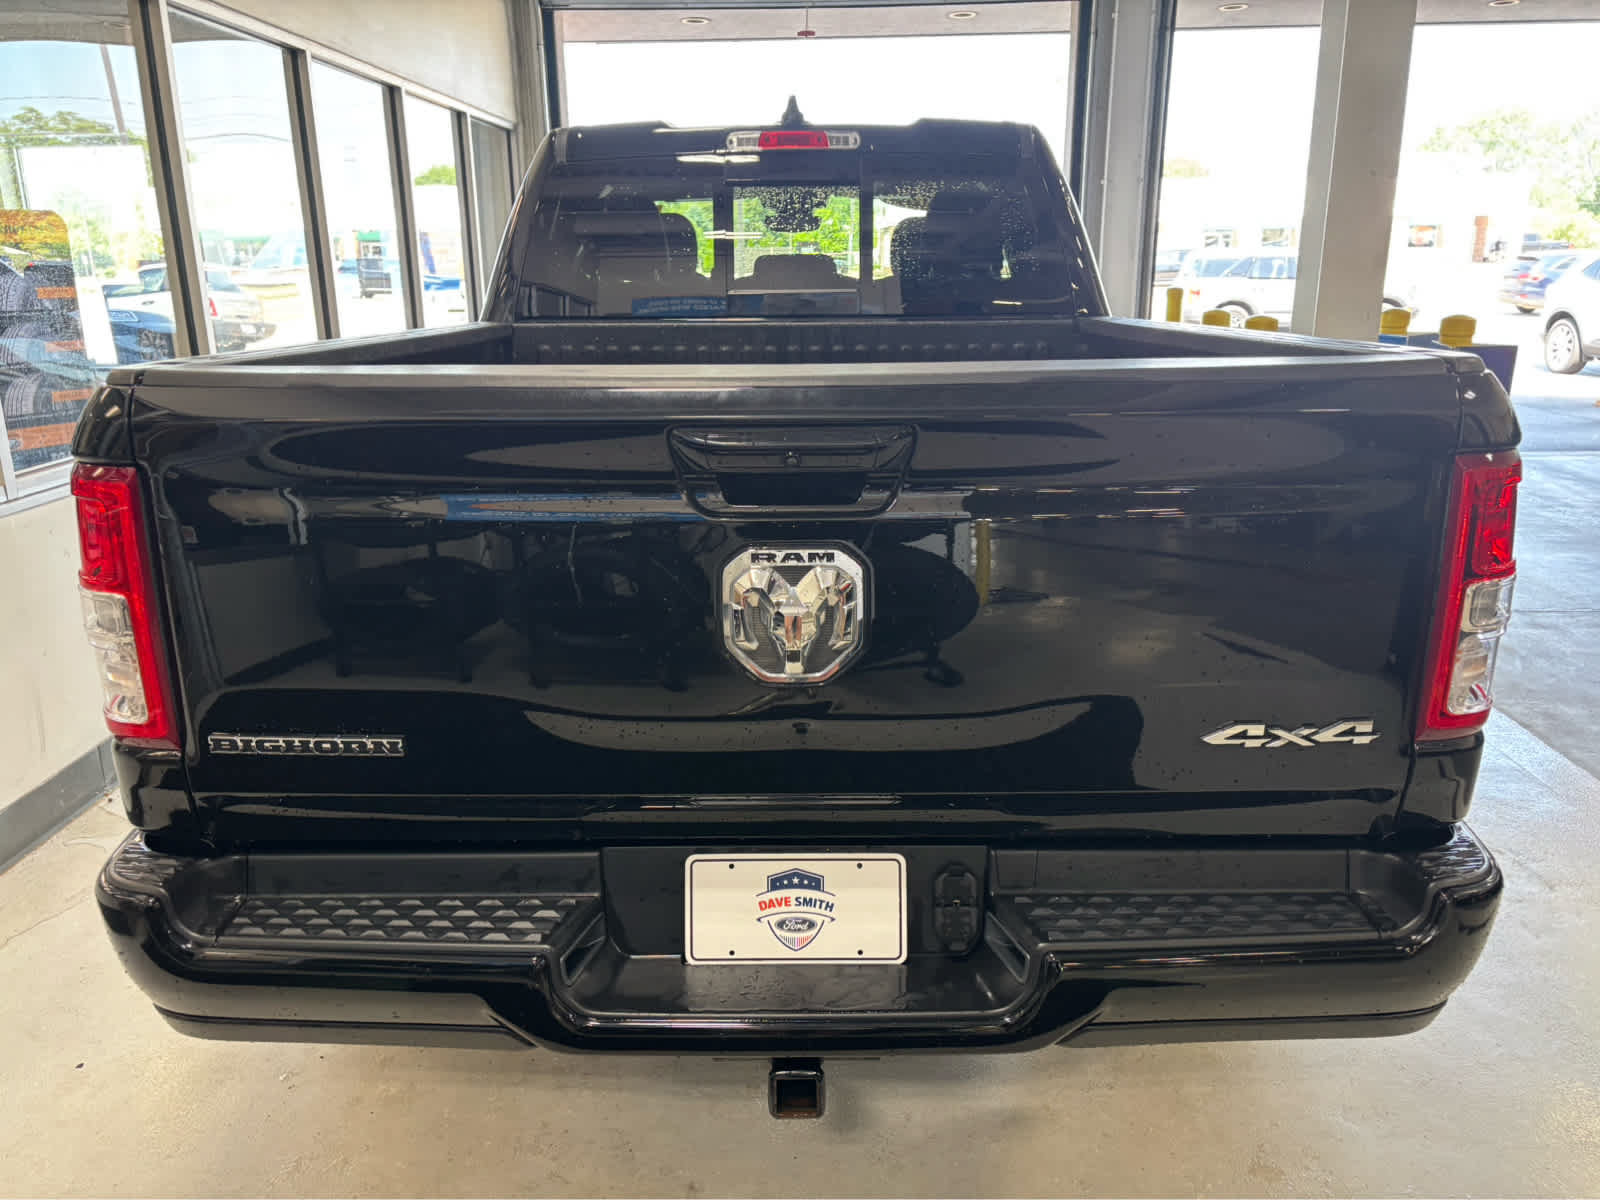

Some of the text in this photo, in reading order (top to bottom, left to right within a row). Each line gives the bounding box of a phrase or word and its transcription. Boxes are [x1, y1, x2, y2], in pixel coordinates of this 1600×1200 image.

[751, 552, 835, 563] RAM
[758, 896, 835, 912] DAVE SMITH
[783, 918, 810, 930] Ford
